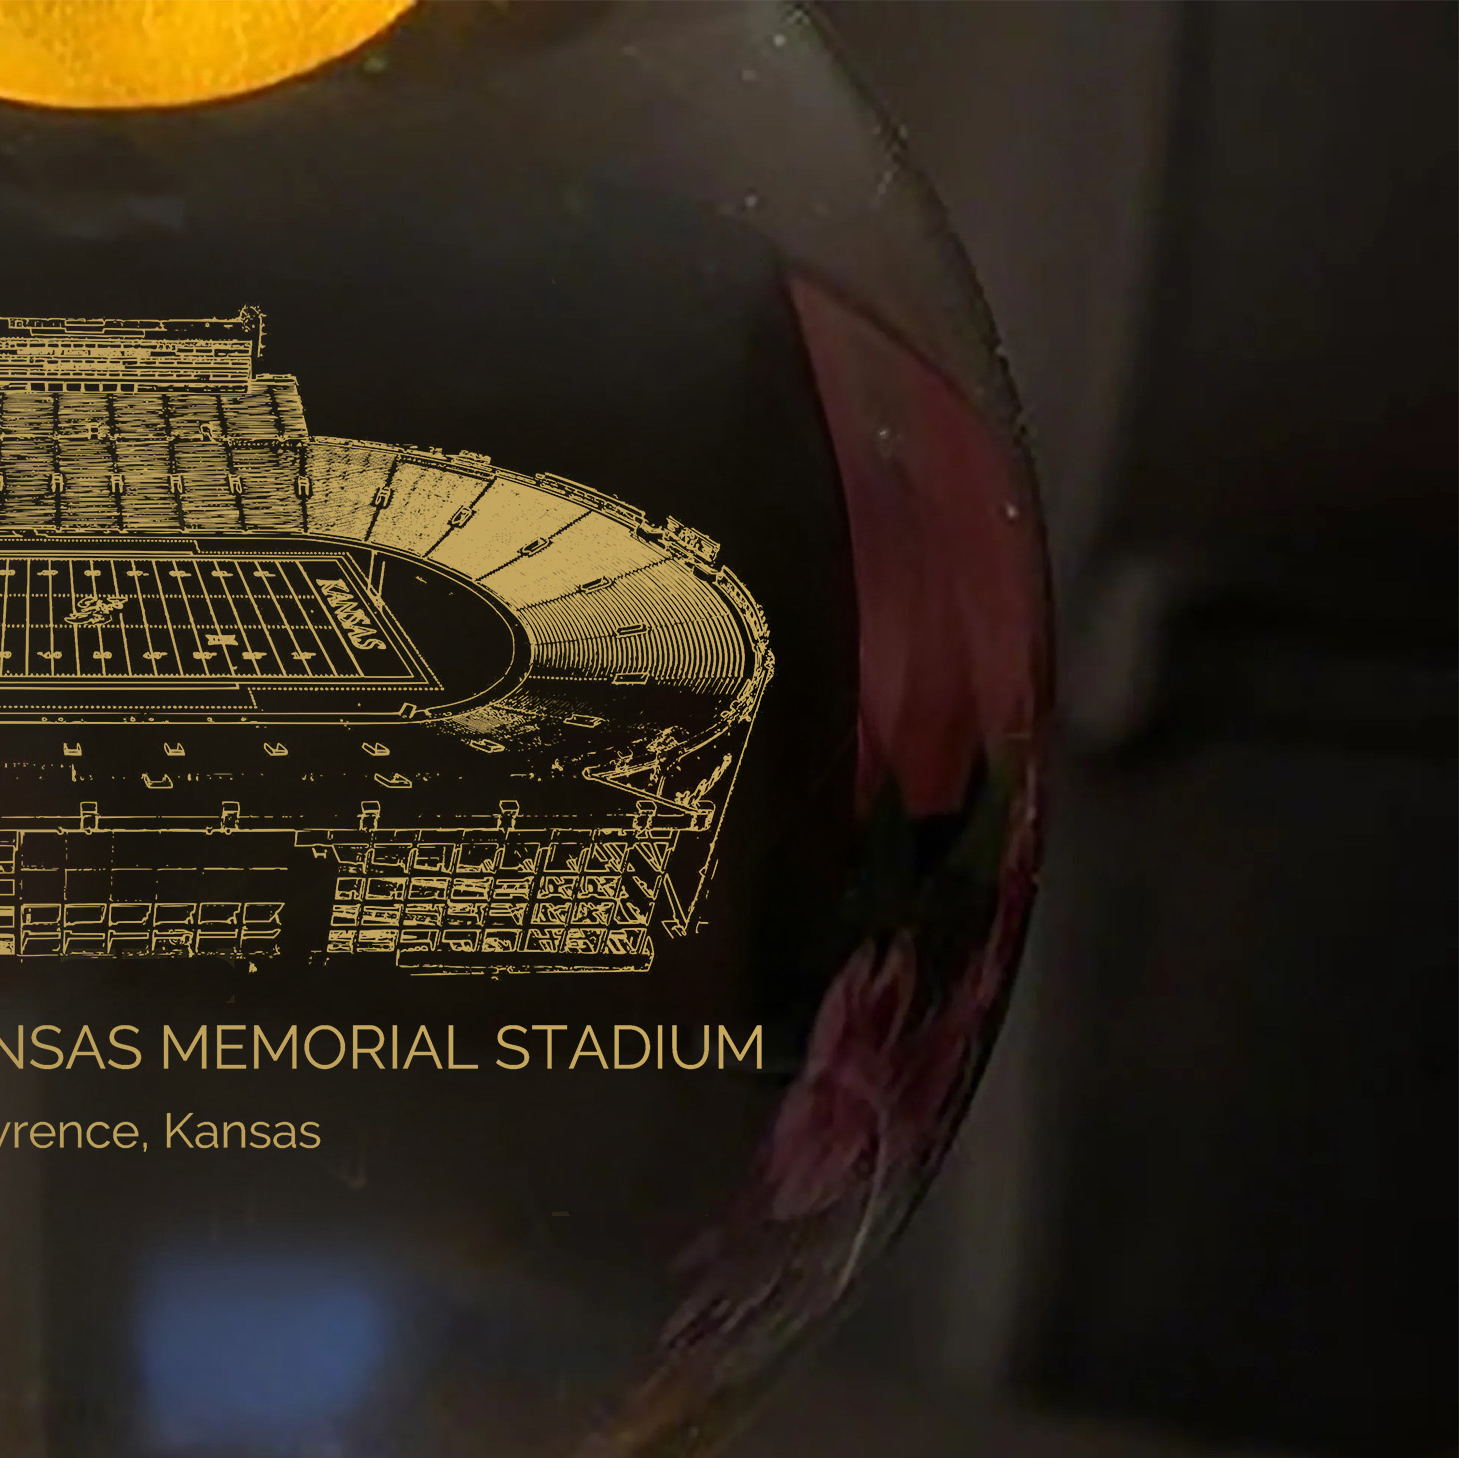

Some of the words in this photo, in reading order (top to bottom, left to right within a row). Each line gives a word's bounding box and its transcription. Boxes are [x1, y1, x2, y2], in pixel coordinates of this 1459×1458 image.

[162, 1023, 479, 1070] MEMORIAL
[494, 1023, 764, 1070] STADIUM
[165, 1111, 322, 1150] Kansas
